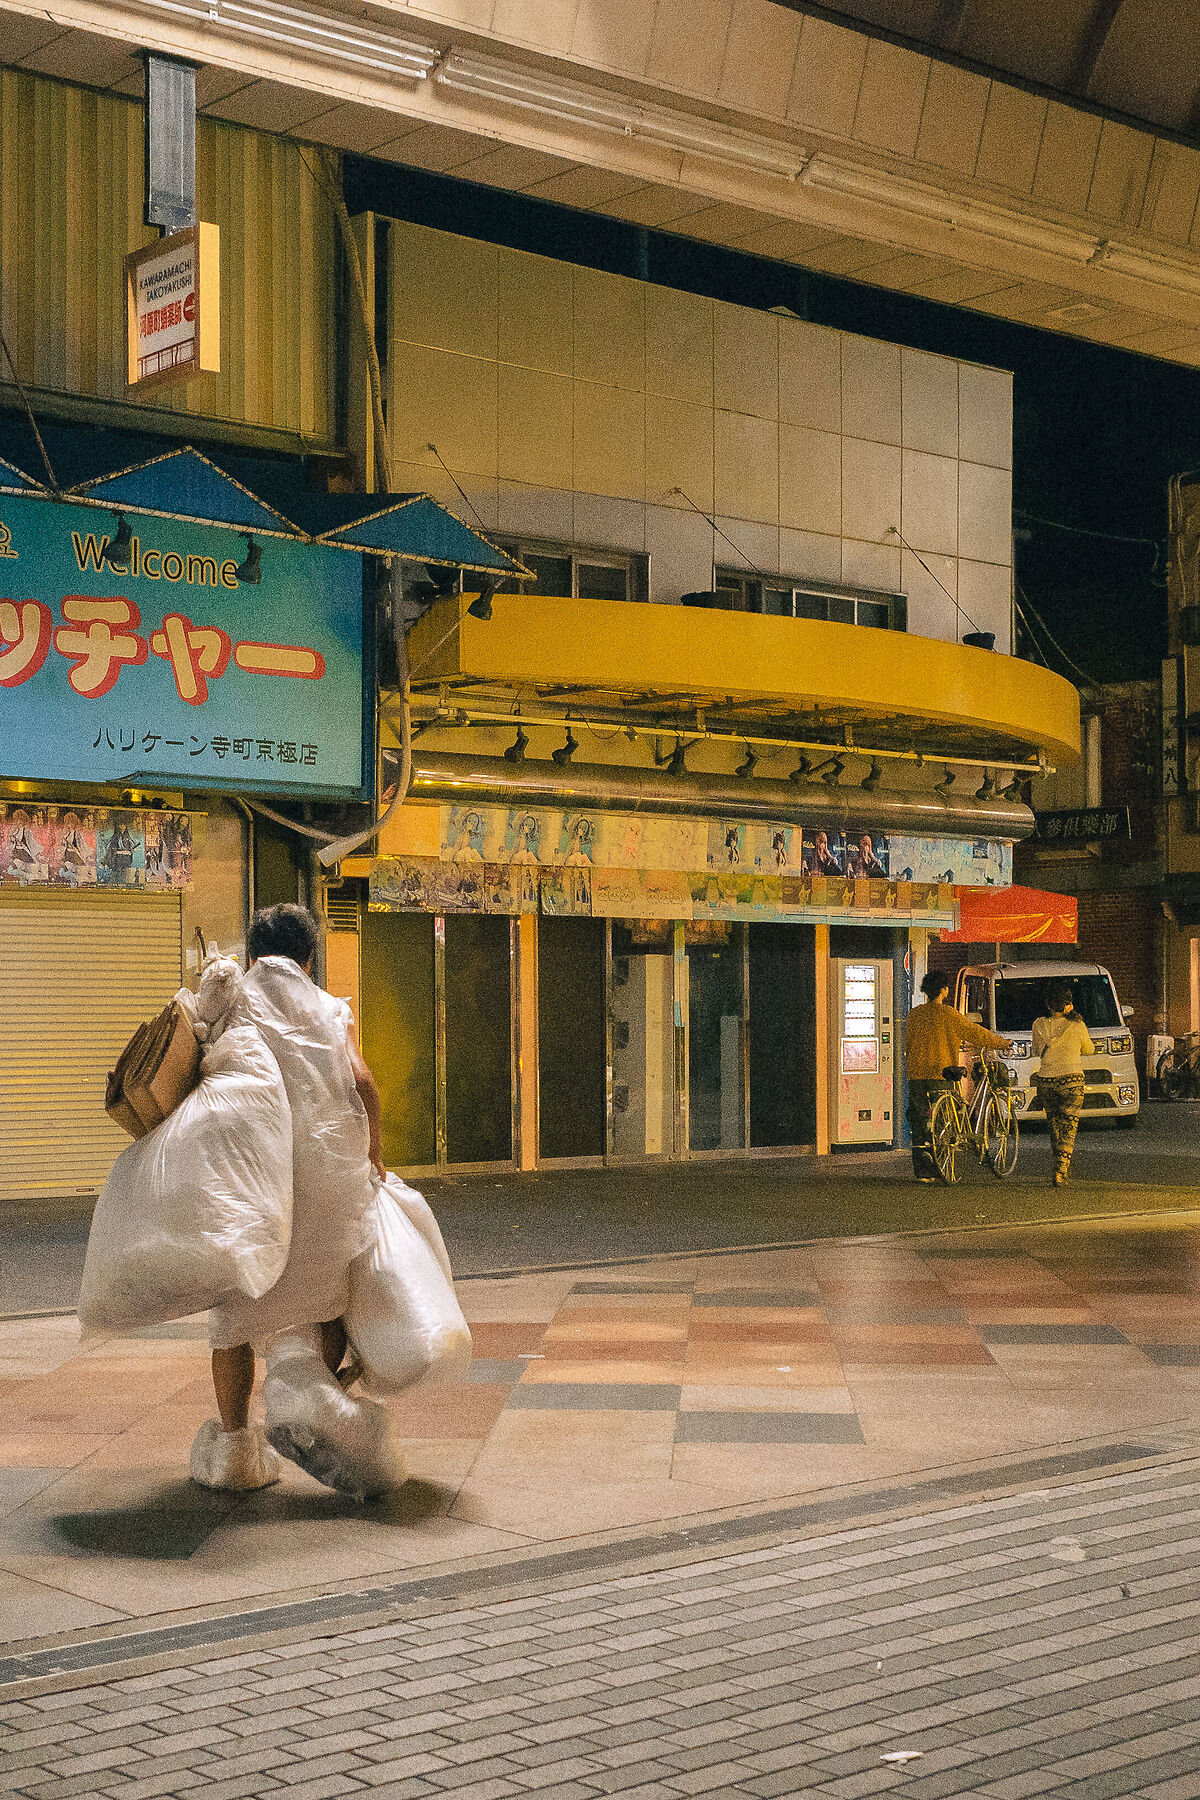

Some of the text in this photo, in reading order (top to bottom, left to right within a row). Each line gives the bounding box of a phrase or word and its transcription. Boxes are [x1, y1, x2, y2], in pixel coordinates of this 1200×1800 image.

[139, 259, 192, 291] KAWARAMACHI
[146, 273, 192, 303] TAKOYAKUSHI
[71, 532, 239, 589] Wlcome
[93, 726, 319, 766] ハリケーン寺町京極店
